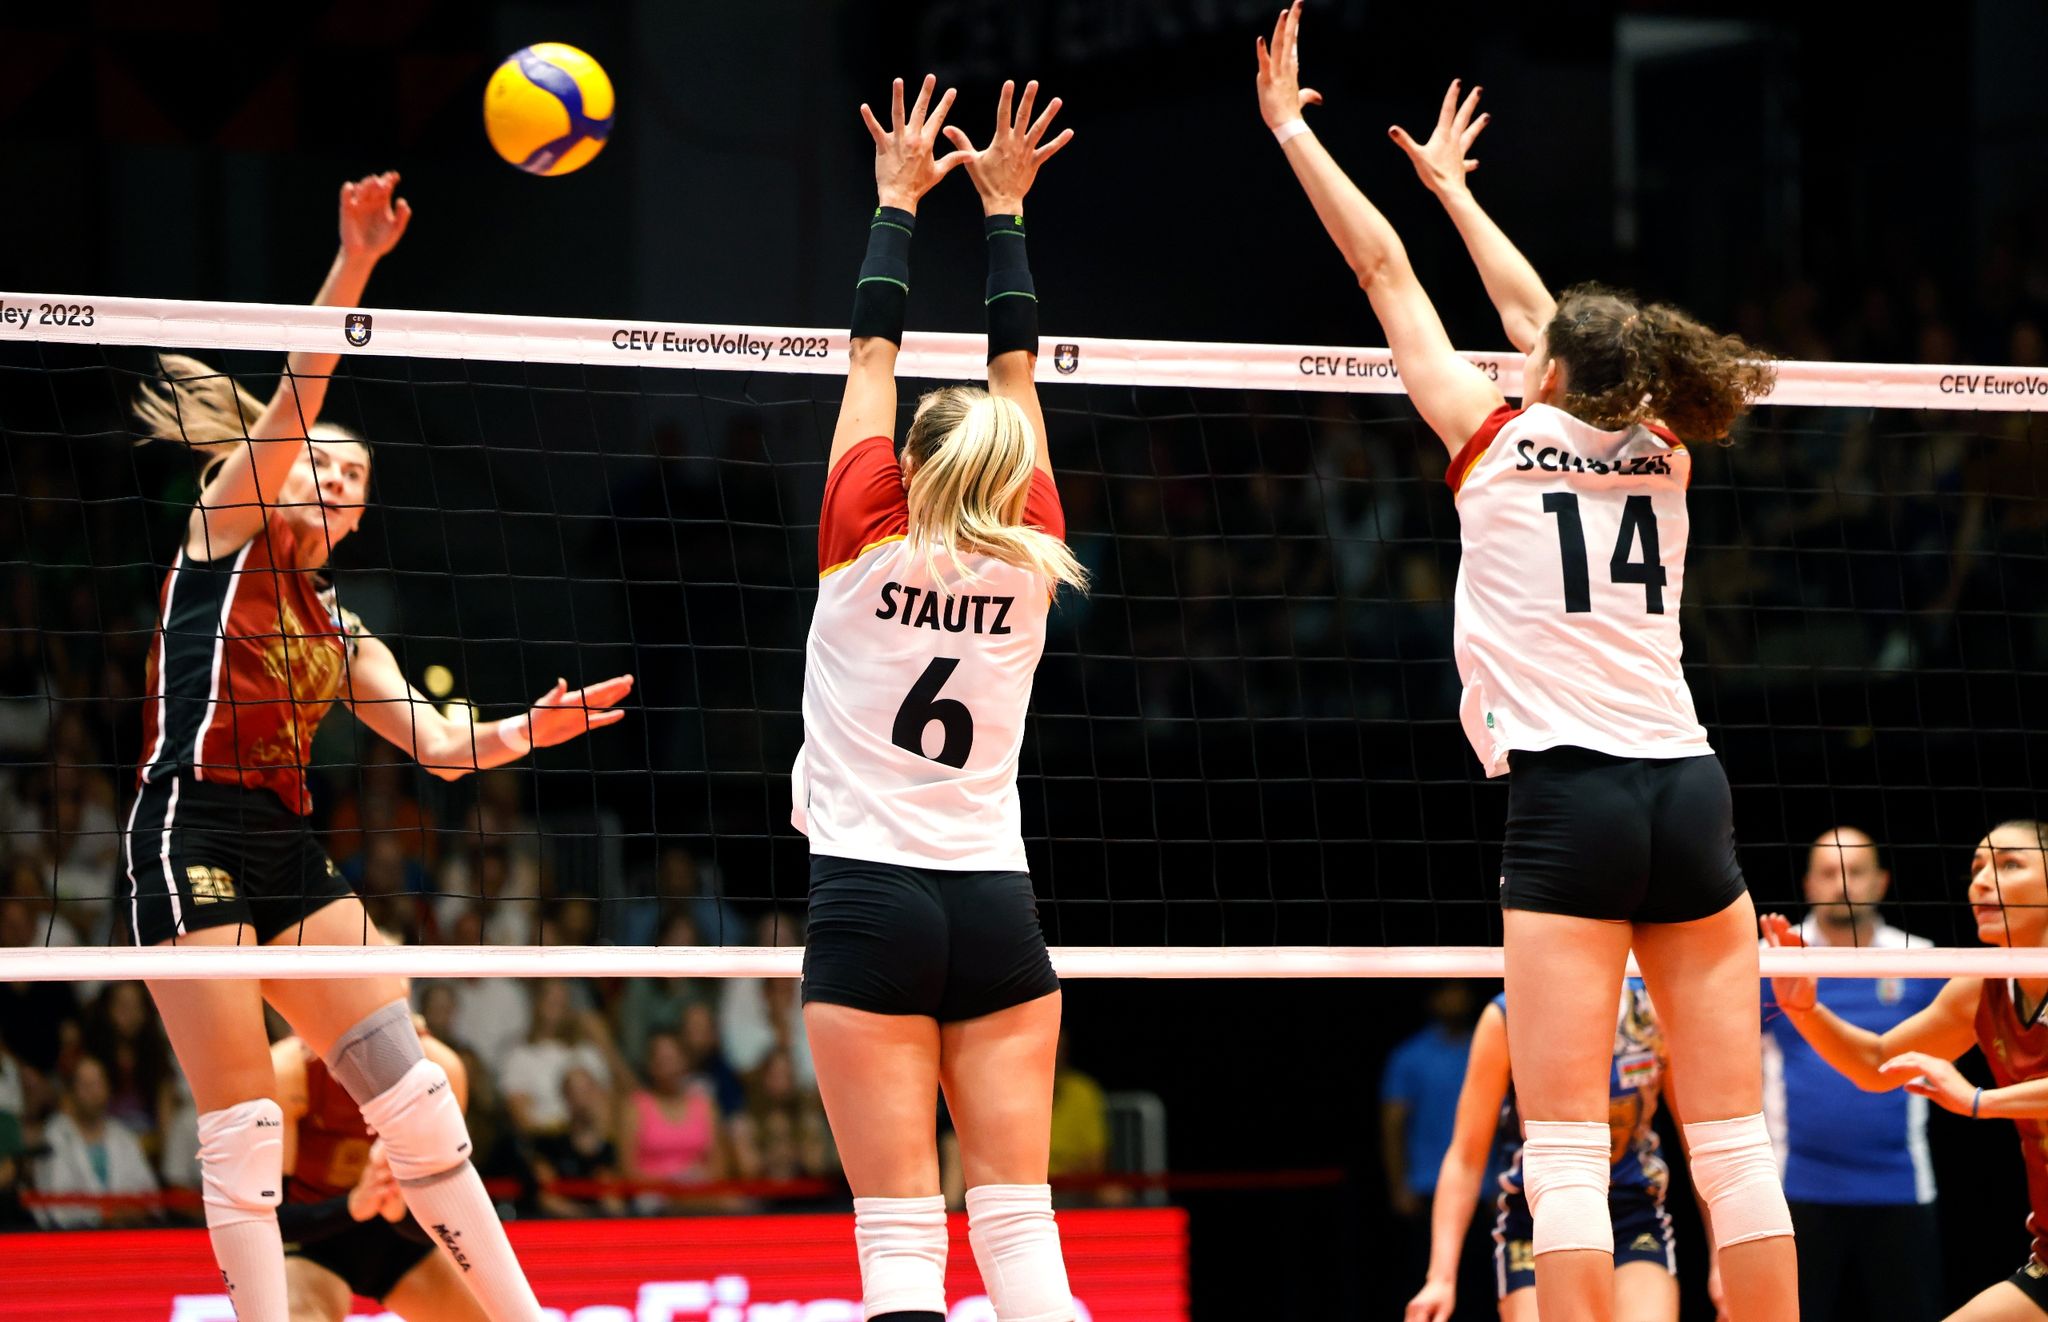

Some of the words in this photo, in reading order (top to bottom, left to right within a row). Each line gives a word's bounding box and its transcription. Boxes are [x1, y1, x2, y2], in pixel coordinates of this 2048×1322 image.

[39, 303, 95, 327] 2023
[612, 329, 658, 351] CEV
[662, 331, 773, 361] EuroVolley
[779, 336, 829, 358] 2023
[1299, 356, 1341, 376] CEV
[1345, 357, 1398, 378] EuroV
[1940, 375, 1980, 394] CEV
[1542, 491, 1667, 615] 14
[875, 581, 1016, 635] STAUTZ
[891, 656, 974, 770] 6
